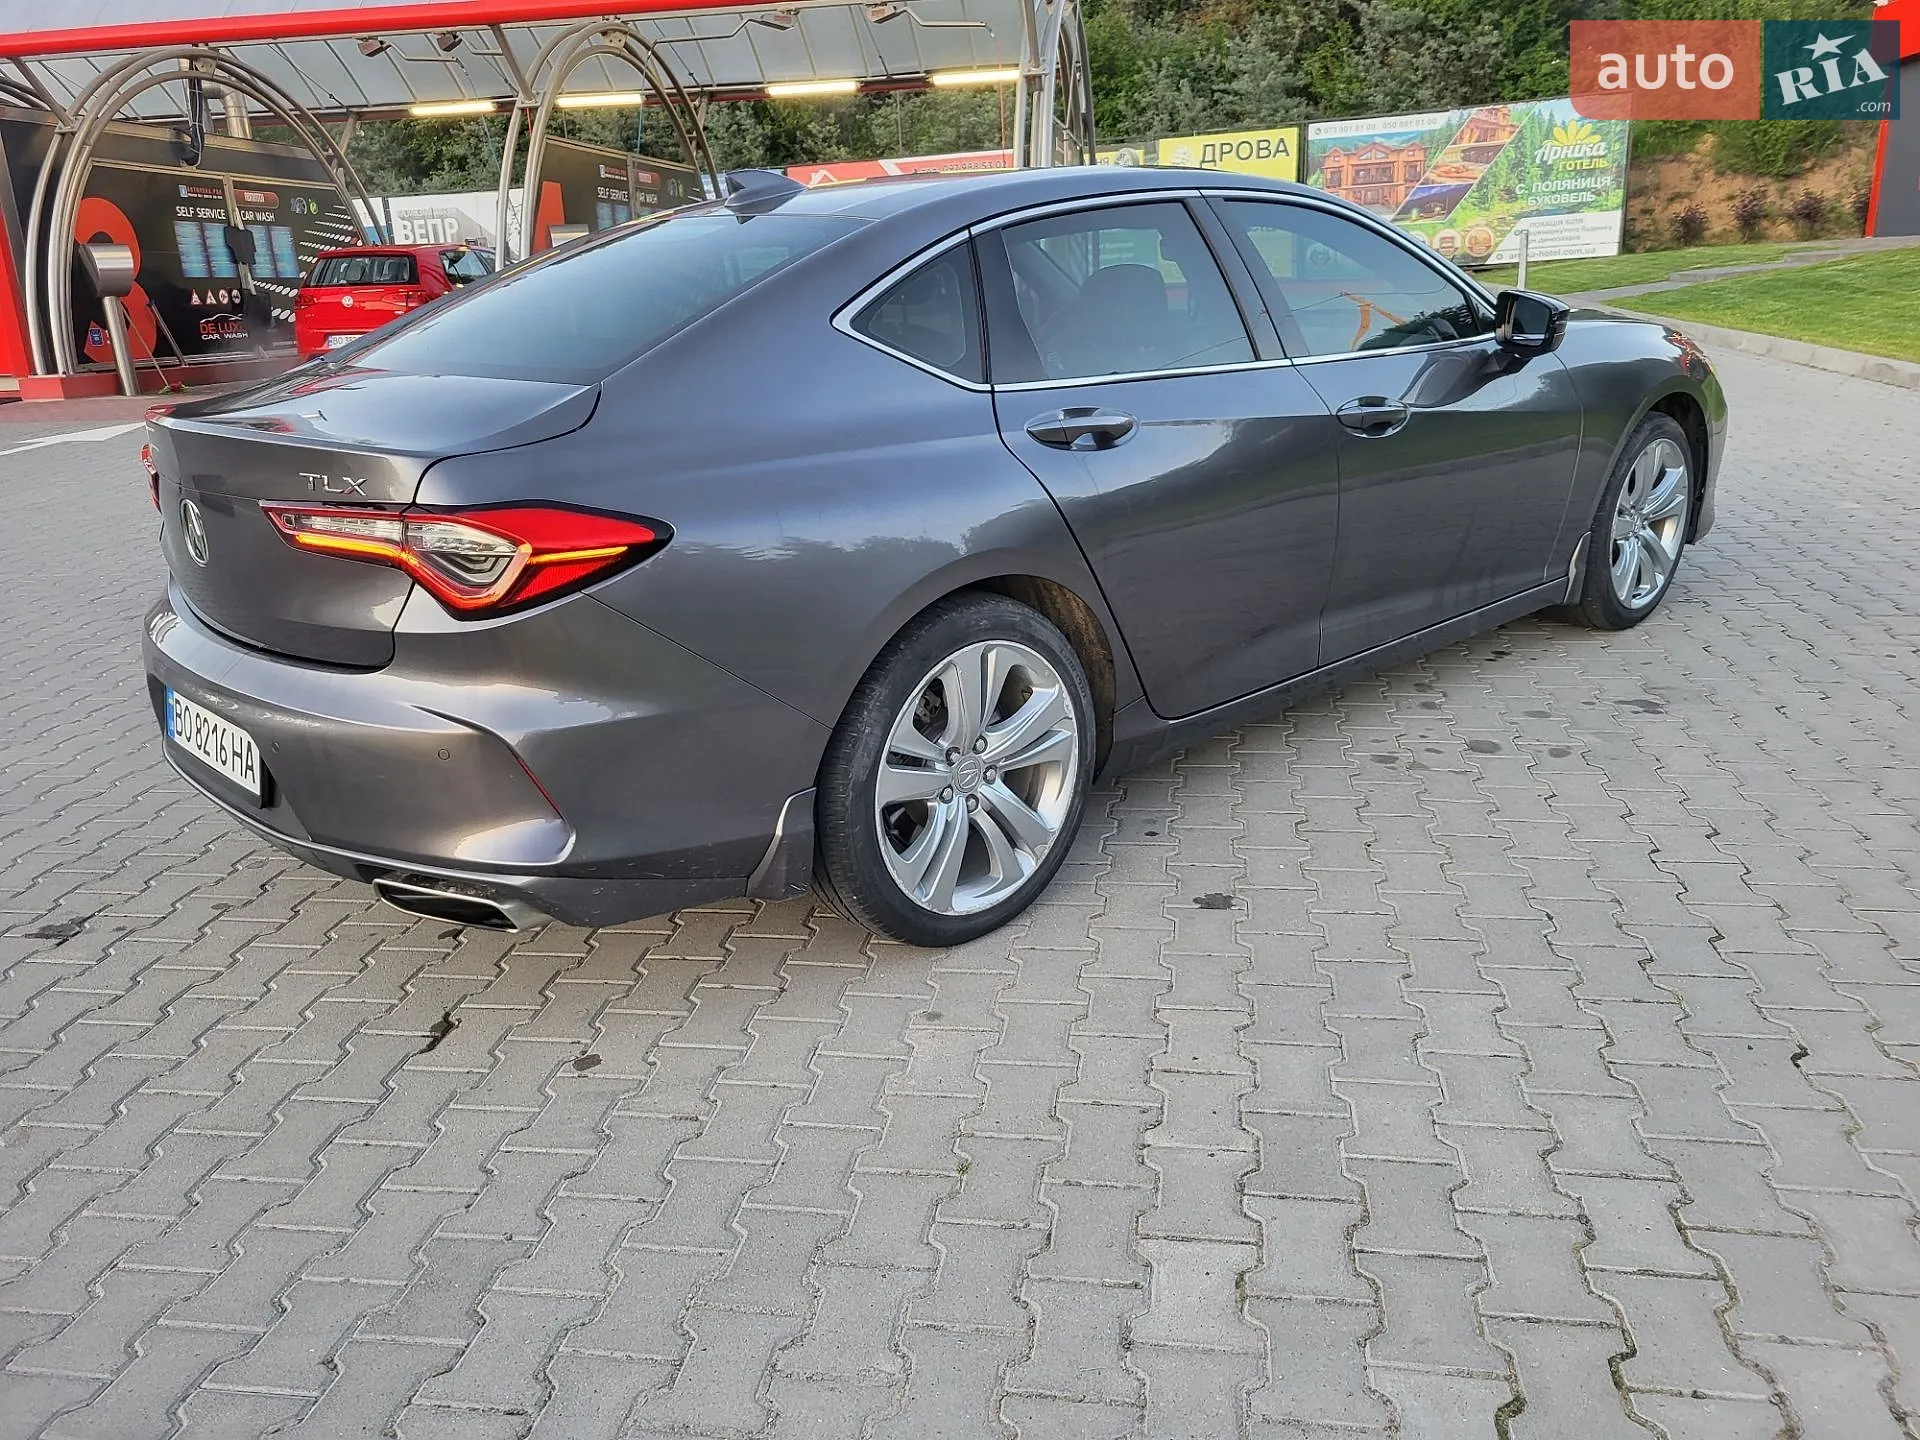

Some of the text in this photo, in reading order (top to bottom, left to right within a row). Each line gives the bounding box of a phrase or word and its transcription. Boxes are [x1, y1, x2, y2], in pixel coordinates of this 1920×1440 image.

[1200, 137, 1290, 168] ДРОВА
[1560, 158, 1608, 170] ГОТЕЛЬ
[1532, 176, 1611, 192] ПОЛЯНИЦЯ
[1527, 191, 1597, 206] БУКОВЕЛЬ
[176, 206, 276, 222] SELF SERVICE CAR WASH
[397, 217, 459, 244] ВЕПР
[200, 323, 216, 334] DE
[299, 472, 367, 497] TLX
[174, 697, 256, 785] BO 8216 HA
